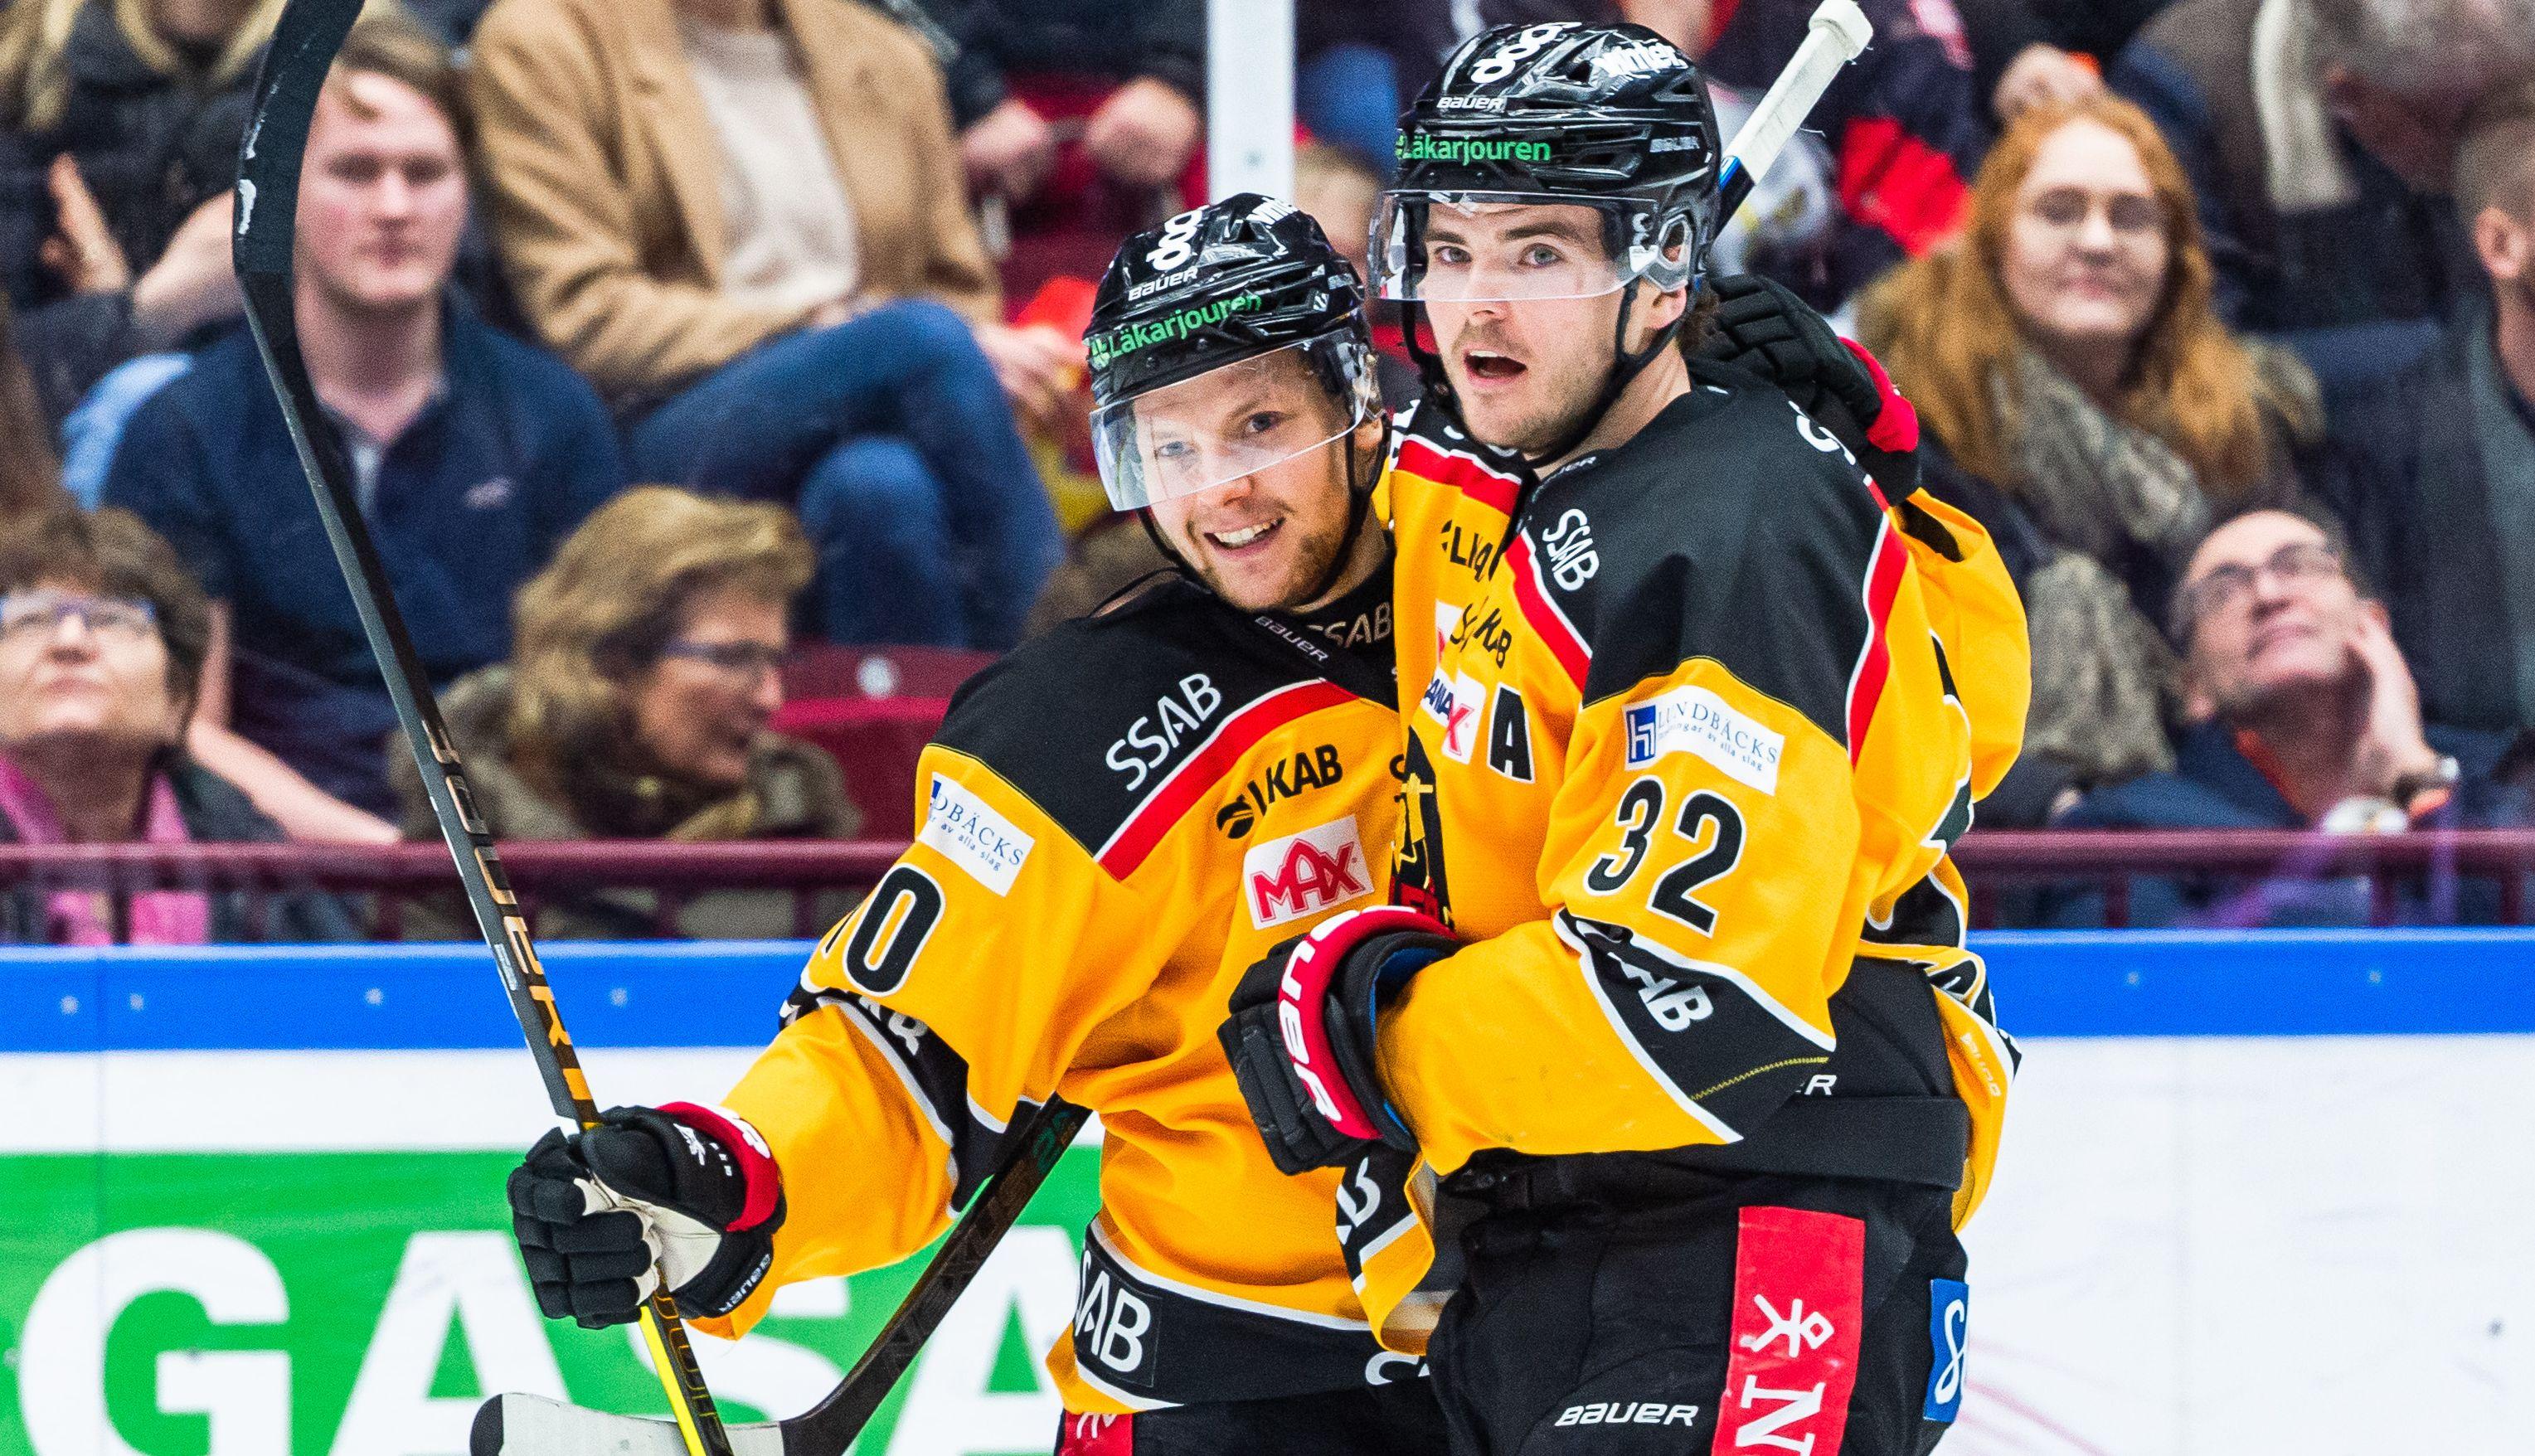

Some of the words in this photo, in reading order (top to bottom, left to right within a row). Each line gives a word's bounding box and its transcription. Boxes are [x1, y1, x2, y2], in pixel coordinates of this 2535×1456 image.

[1436, 96, 1503, 110] BAUER
[1404, 133, 1551, 166] Läkarjouren
[1128, 265, 1199, 302] BAUER
[1109, 294, 1262, 358] Läkarjouren
[1542, 508, 1600, 592] SSAB
[1255, 615, 1328, 662] BAUER
[1106, 673, 1222, 792] SSAB
[1489, 685, 1534, 781] A
[934, 794, 1024, 866] DBÄCKS
[1585, 776, 1744, 936] 32
[1251, 837, 1366, 923] MAX
[1076, 1250, 1152, 1372] AB
[1554, 1401, 1699, 1427] BAUER
